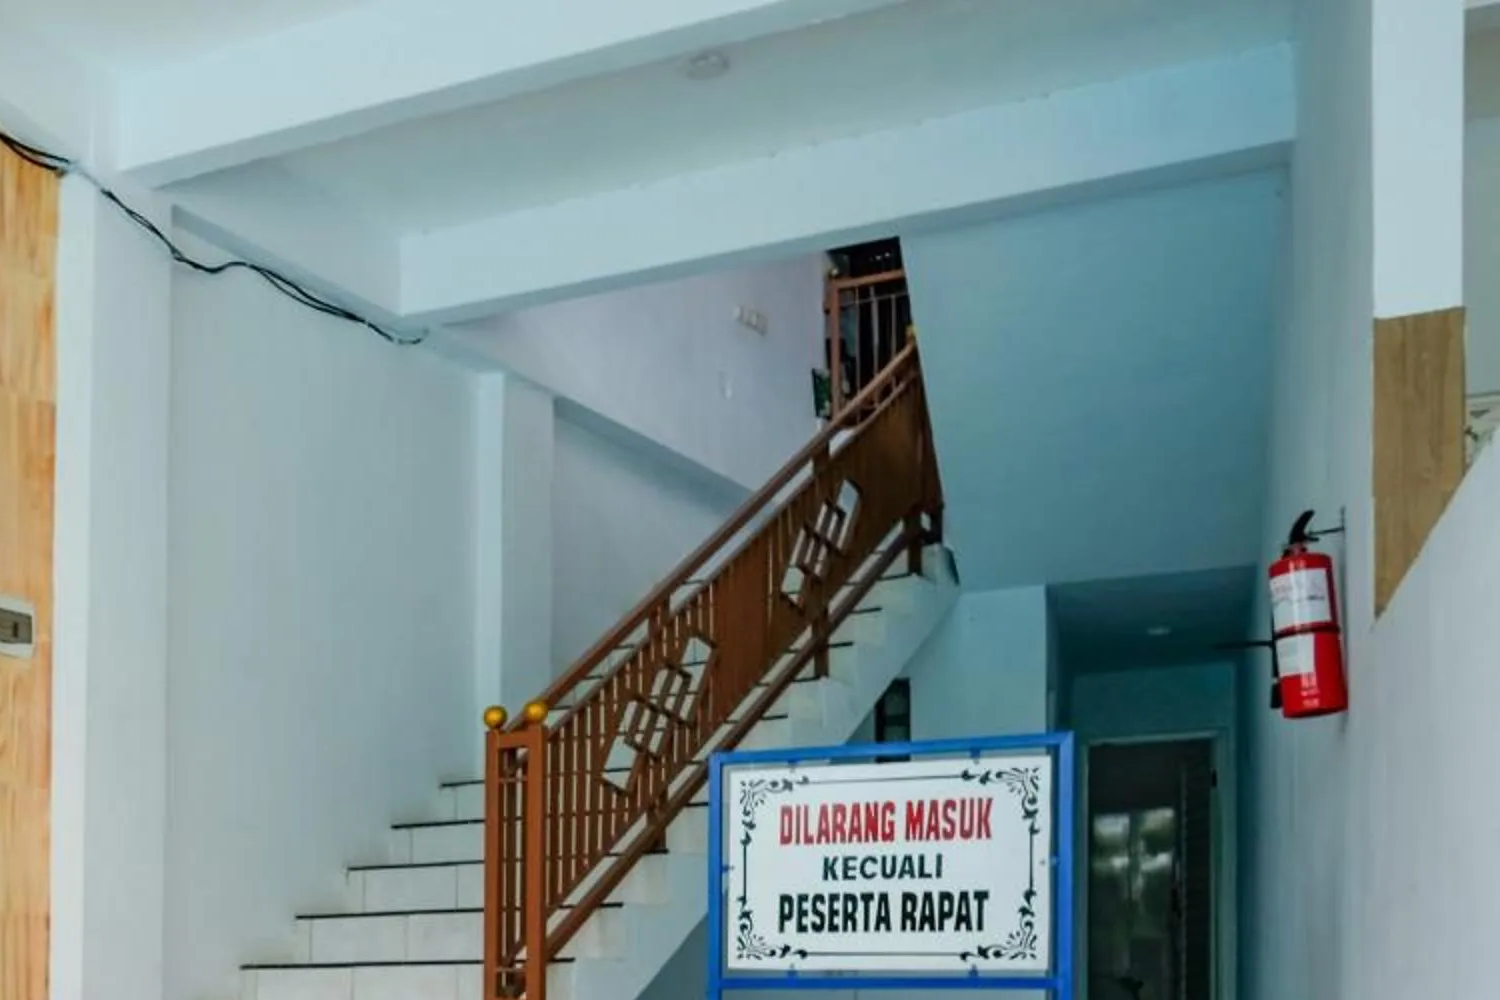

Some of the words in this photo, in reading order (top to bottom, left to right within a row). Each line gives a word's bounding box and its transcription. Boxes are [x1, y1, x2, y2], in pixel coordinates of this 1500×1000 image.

[779, 801, 896, 845] DILARANG
[904, 798, 993, 840] MASUK
[822, 854, 943, 881] KECUALI
[778, 892, 892, 933] PESERTA
[900, 890, 990, 932] RAPAT
